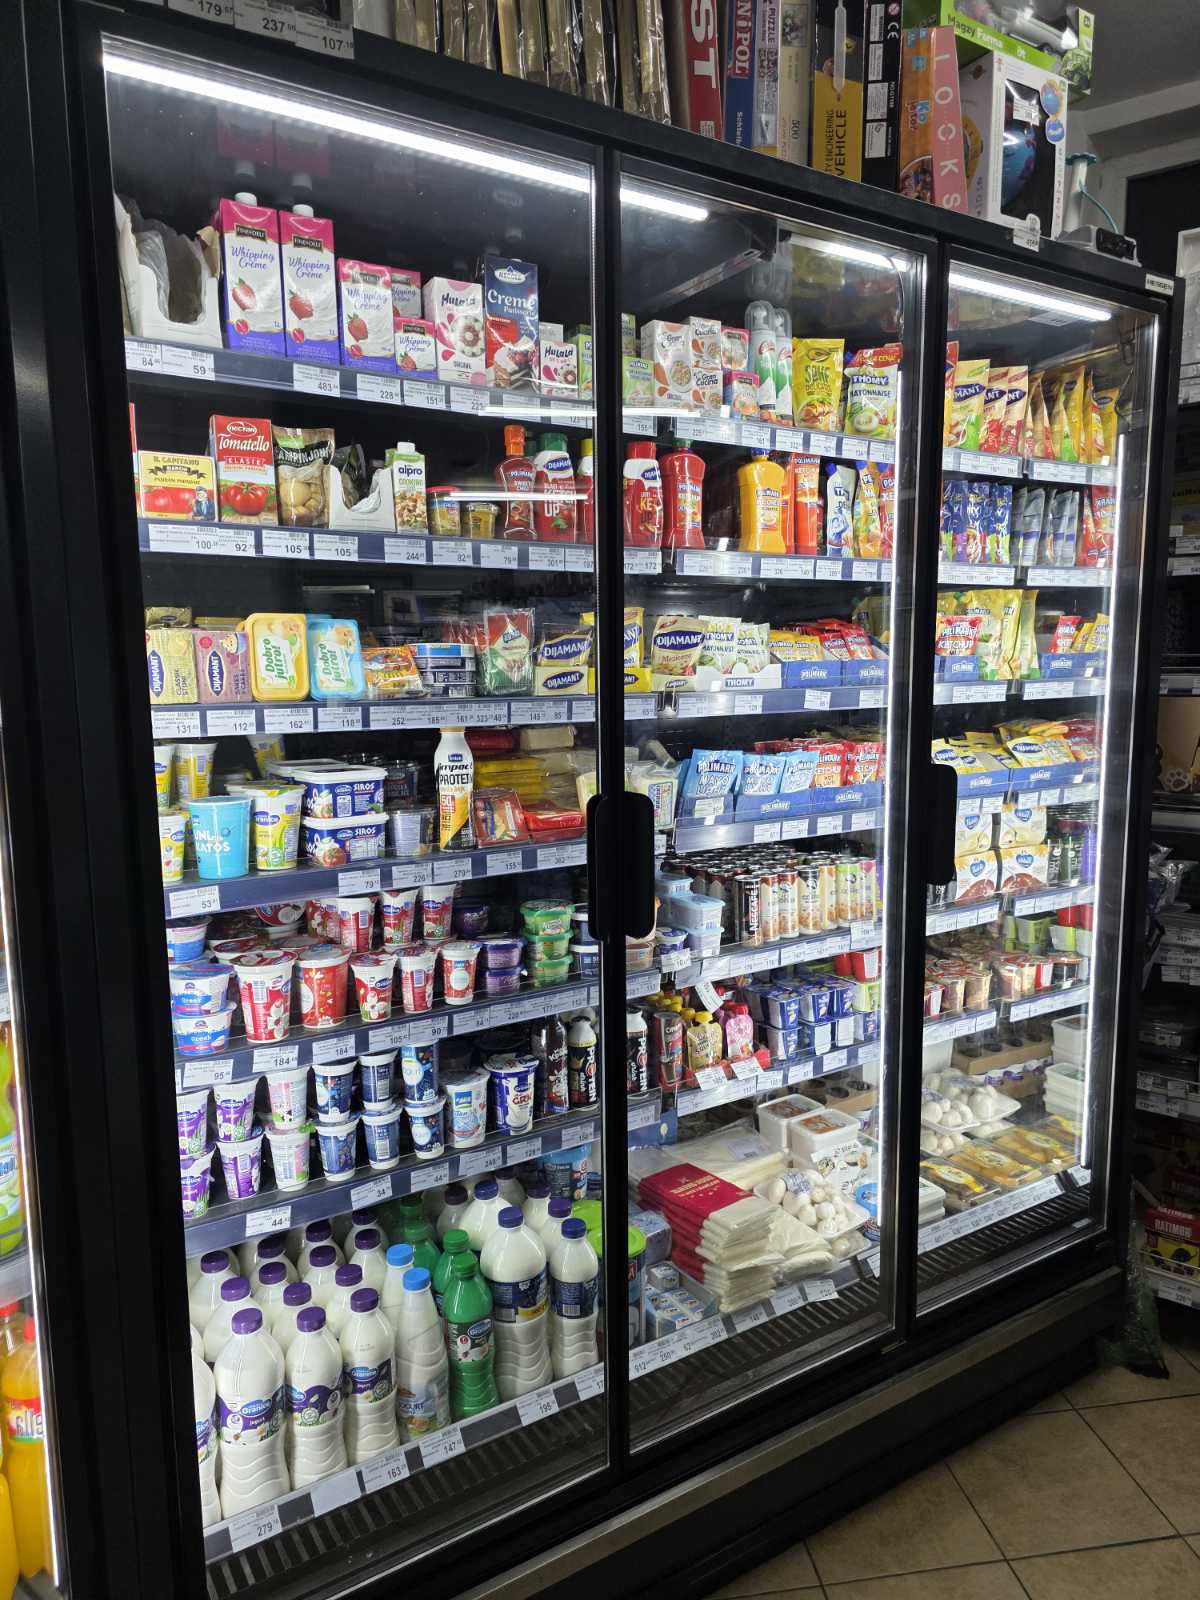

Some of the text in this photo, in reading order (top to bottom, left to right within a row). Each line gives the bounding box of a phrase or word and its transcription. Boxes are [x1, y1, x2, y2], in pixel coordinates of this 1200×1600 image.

[262, 17, 285, 33] 237
[322, 35, 343, 51] 107
[834, 109, 847, 177] VEHICLE
[231, 245, 275, 262] Whipping
[288, 256, 330, 273] Whipping
[399, 336, 432, 348] Whipping
[193, 364, 206, 375] 59
[852, 374, 889, 385] THOMY
[317, 382, 333, 392] 483
[218, 433, 270, 452] Tomatello
[398, 466, 423, 477] alpro
[196, 540, 212, 549] 100
[235, 543, 248, 552] 92
[284, 545, 302, 554] 105
[335, 547, 351, 557] 105
[656, 634, 703, 647] DIJAMANT
[265, 637, 275, 673] Dobro
[320, 643, 332, 676] Dobro
[213, 655, 222, 692] DIJAMANT
[546, 672, 580, 688] DIJAMANT
[726, 678, 753, 687] THOMY
[176, 724, 192, 734] 131
[233, 722, 248, 731] 112
[288, 720, 303, 729] 162
[697, 761, 736, 774] POLIMARK
[353, 783, 376, 791] SIROS
[354, 827, 376, 836] SIROS
[364, 880, 374, 889] 79
[201, 900, 212, 909] 53
[335, 1048, 348, 1057] 184
[273, 1056, 290, 1066] 184
[214, 1072, 224, 1080] 95
[377, 1189, 386, 1197] 34
[271, 1217, 283, 1227] 44
[386, 1469, 401, 1479] 163
[256, 1522, 273, 1537] 279
